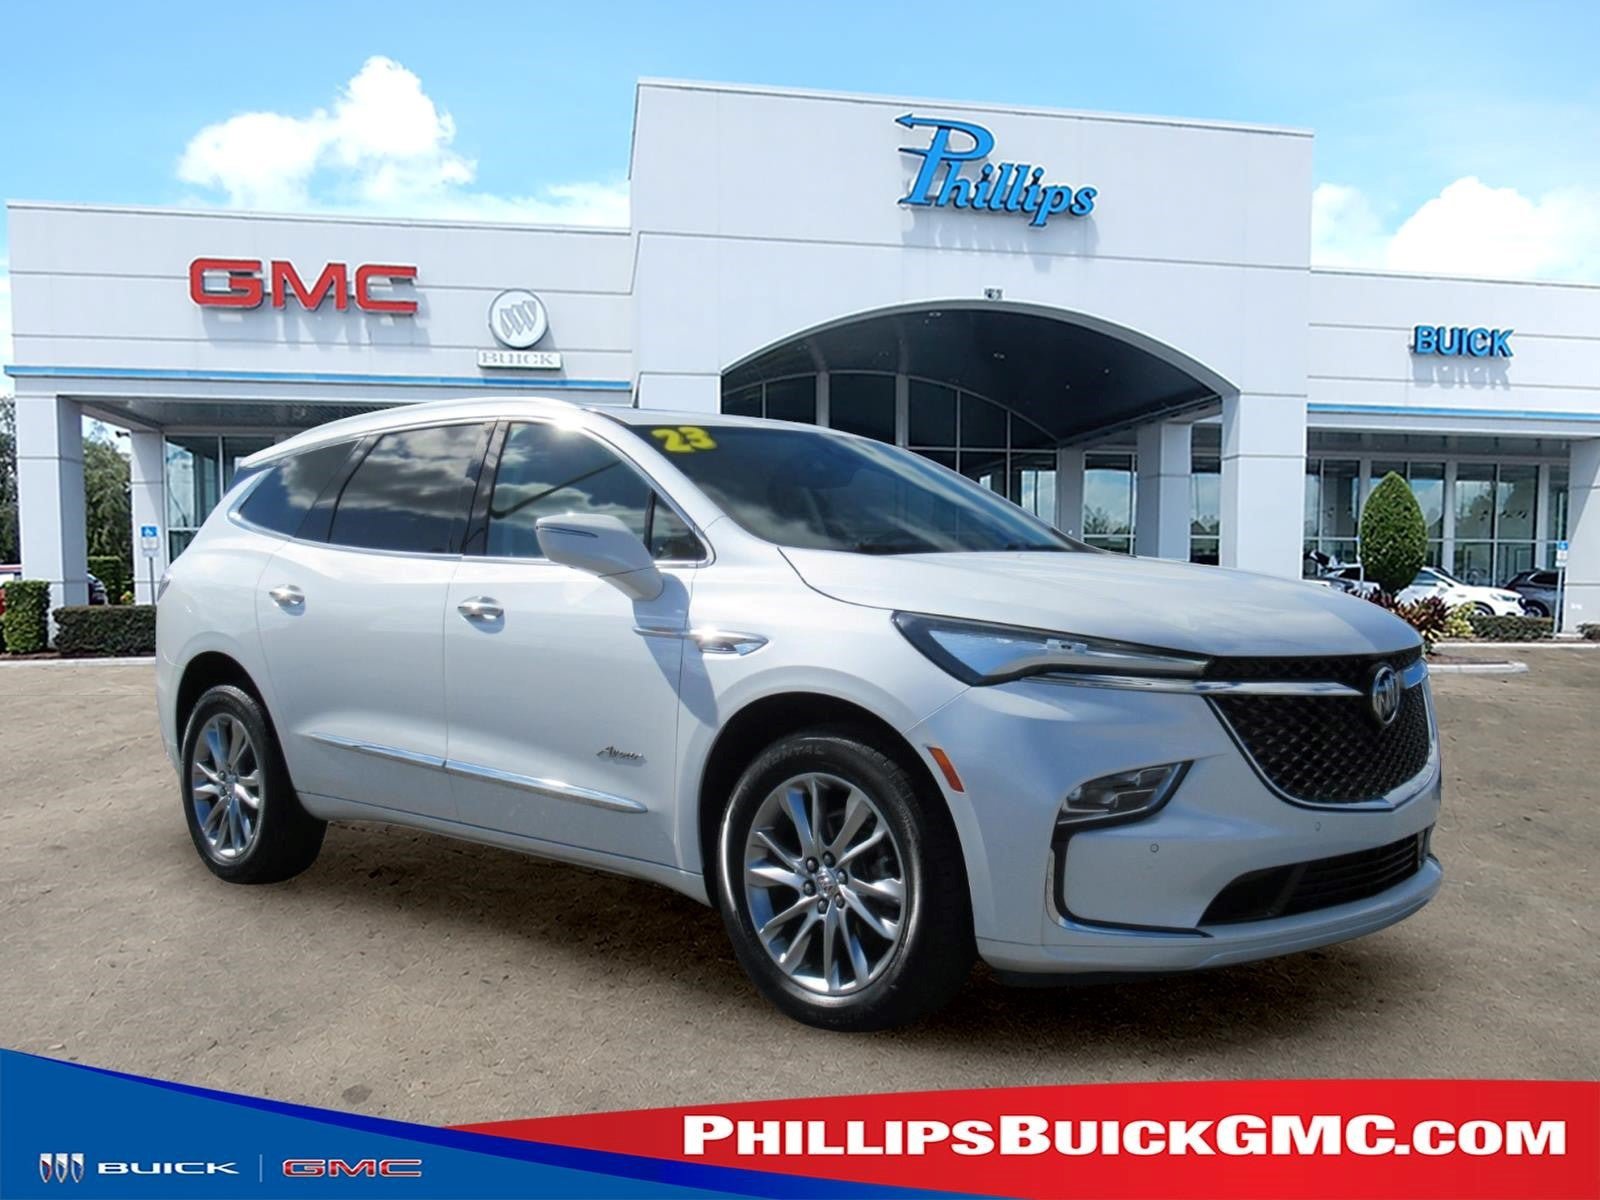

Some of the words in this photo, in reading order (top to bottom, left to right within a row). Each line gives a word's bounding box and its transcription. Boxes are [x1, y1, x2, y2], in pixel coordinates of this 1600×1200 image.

[895, 114, 1097, 227] Phillips
[189, 257, 418, 314] GMC
[1414, 325, 1514, 357] BUICK
[482, 352, 554, 365] BUICK
[651, 427, 717, 452] 23
